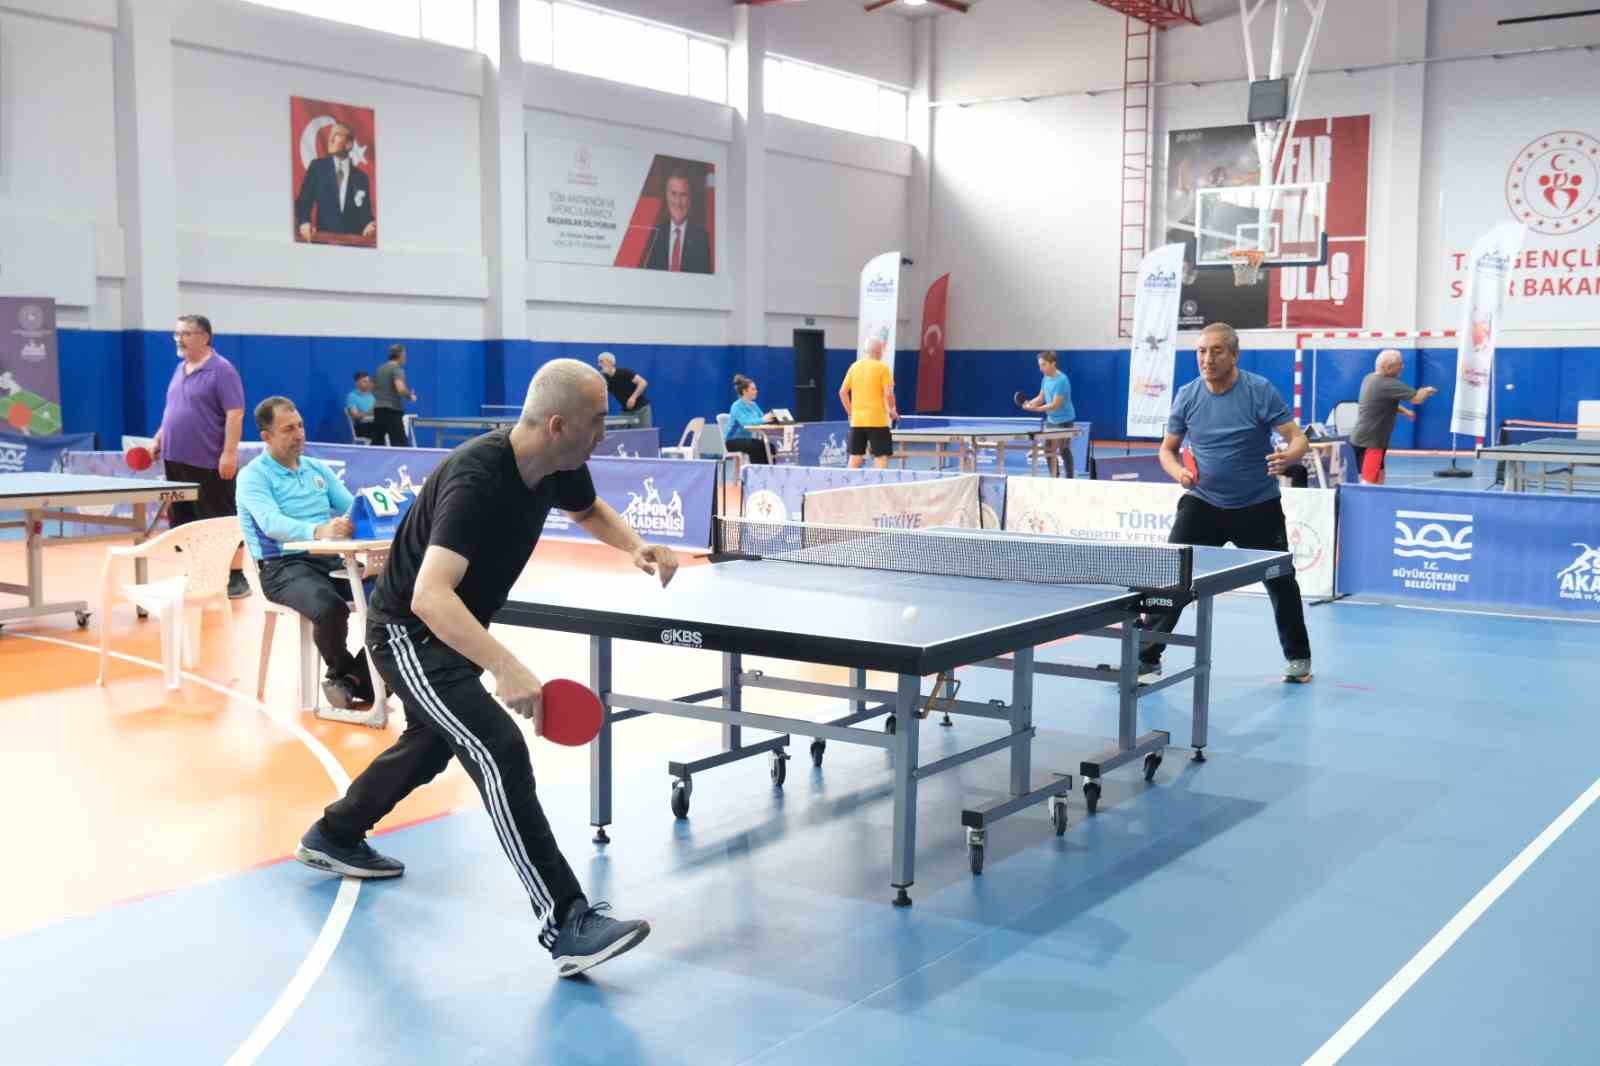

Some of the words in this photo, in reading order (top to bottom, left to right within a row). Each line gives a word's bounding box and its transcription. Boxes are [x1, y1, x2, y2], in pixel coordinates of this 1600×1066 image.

[373, 491, 388, 512] 9
[1392, 567, 1471, 583] BÜYÜKÇEKMECE
[1404, 579, 1457, 592] BELEDİYESİ
[672, 629, 703, 645] KBS
